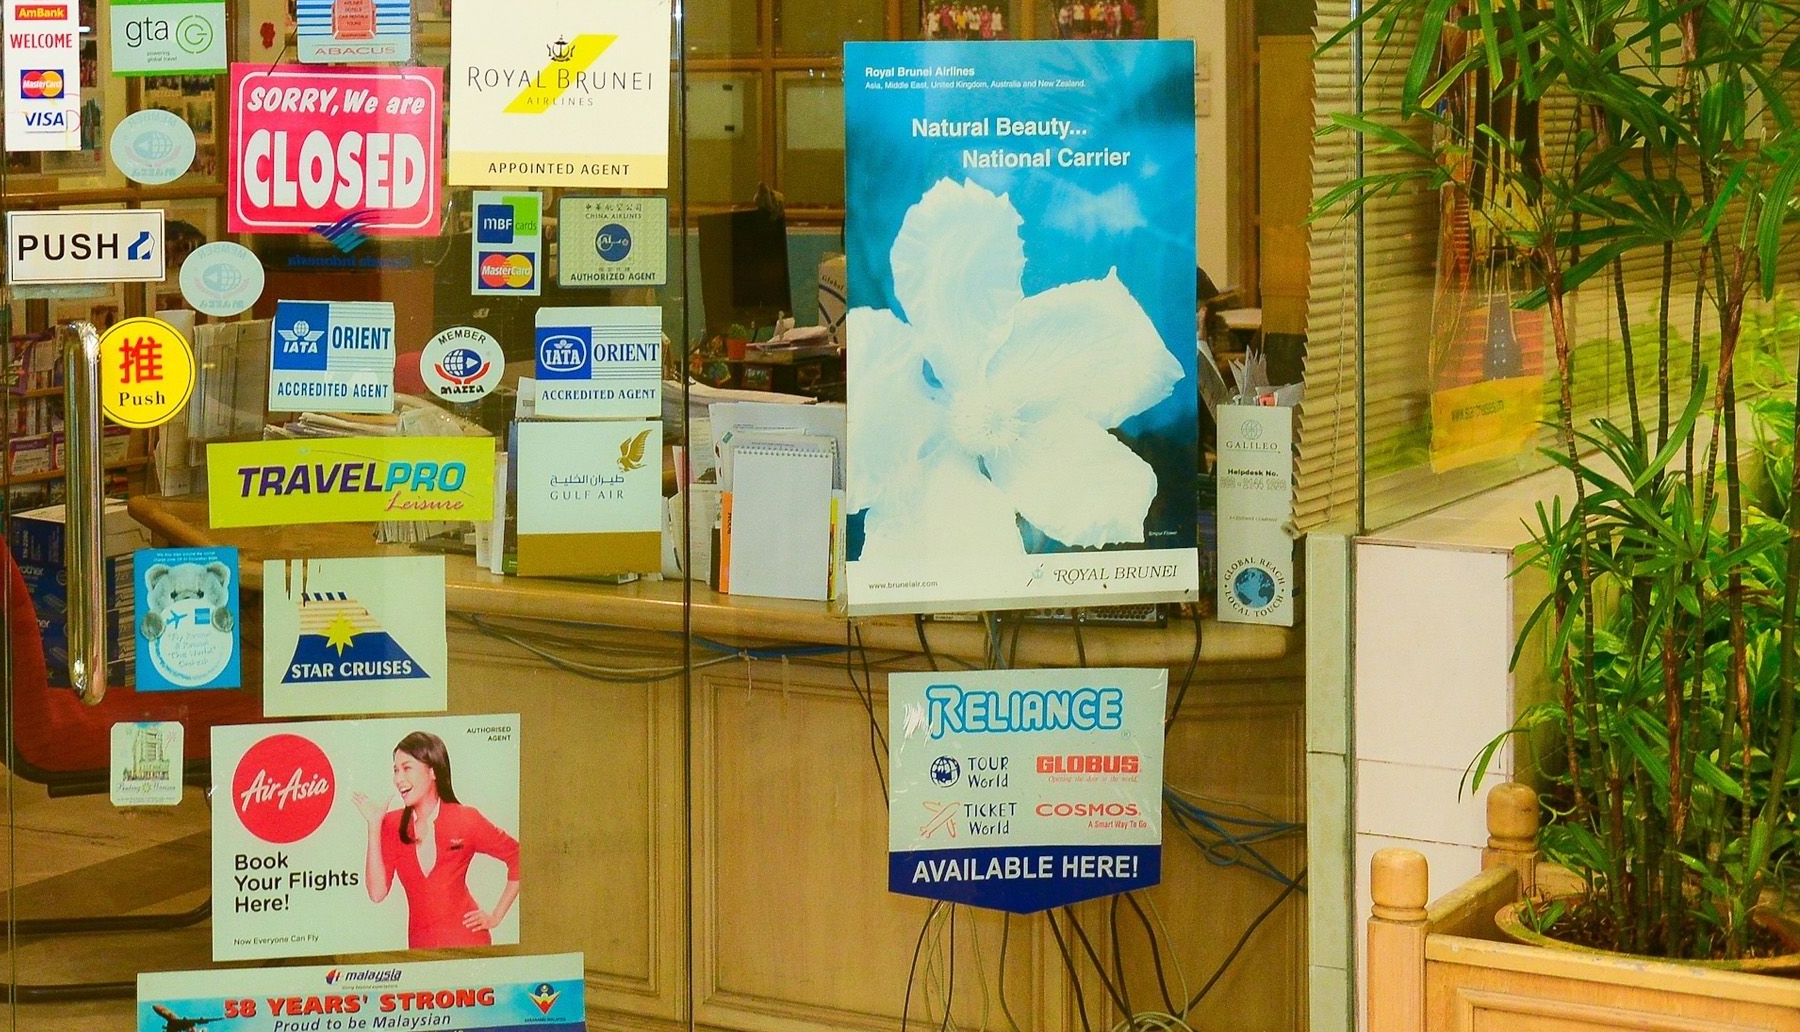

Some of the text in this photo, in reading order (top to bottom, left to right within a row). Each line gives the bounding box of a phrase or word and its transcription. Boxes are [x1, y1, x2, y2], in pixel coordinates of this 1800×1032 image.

[18, 7, 65, 19] AmBank
[125, 16, 169, 48] gta
[9, 33, 73, 49] WELCOME
[315, 47, 395, 55] ABACUS
[468, 66, 653, 94] ROYAL BRUNEI
[865, 66, 975, 78] Royal Brunei Airlines
[865, 79, 1086, 90] Asia, Middle East, United Kingdom, Australia and New Zealand.
[526, 96, 593, 106] AIRLINES
[25, 111, 64, 127] VISA
[962, 148, 1131, 169] National Carrier
[243, 129, 426, 210] CLOSED
[488, 162, 629, 176] APPOINTED AGENT
[17, 233, 119, 261] PUSH
[481, 264, 533, 277] MasterCard
[571, 273, 625, 281] AUTHORIZED
[283, 325, 391, 354] IATA ORIENT
[437, 329, 487, 346] MEMBER
[118, 335, 163, 385] 推
[545, 342, 660, 366] IATA ORIENT
[118, 391, 166, 407] Push
[277, 383, 389, 399] ACCREDITED AGENT
[541, 388, 656, 400] ACCREDITED AGENT
[1225, 441, 1278, 450] GALILEO
[383, 490, 465, 515] Leisure
[550, 490, 624, 500] GULF AIR
[1053, 565, 1178, 586] ROYAL BRUNEI
[291, 659, 413, 680] STAR CRUISES
[926, 684, 1123, 740] RELIANCE
[466, 726, 512, 734] AUTHORISED
[968, 756, 1009, 771] TOUR
[1037, 756, 1138, 773] GLOBUS
[968, 774, 1008, 788] World
[964, 802, 1017, 817] TICKET
[969, 821, 1009, 836] World
[1095, 820, 1113, 828] Smart
[1115, 820, 1128, 830] Way
[1130, 820, 1137, 828] To
[1139, 820, 1147, 828] Go
[234, 853, 289, 871] Book
[912, 856, 1138, 884] AVAILABLE HERE!
[234, 869, 359, 893] Your Flights
[234, 893, 290, 914] Here!
[234, 933, 319, 947] Now Everyone Can Fly
[224, 987, 496, 1019] 58 YEARS' STRONG
[274, 1013, 451, 1032] Proud to be Malaysian
